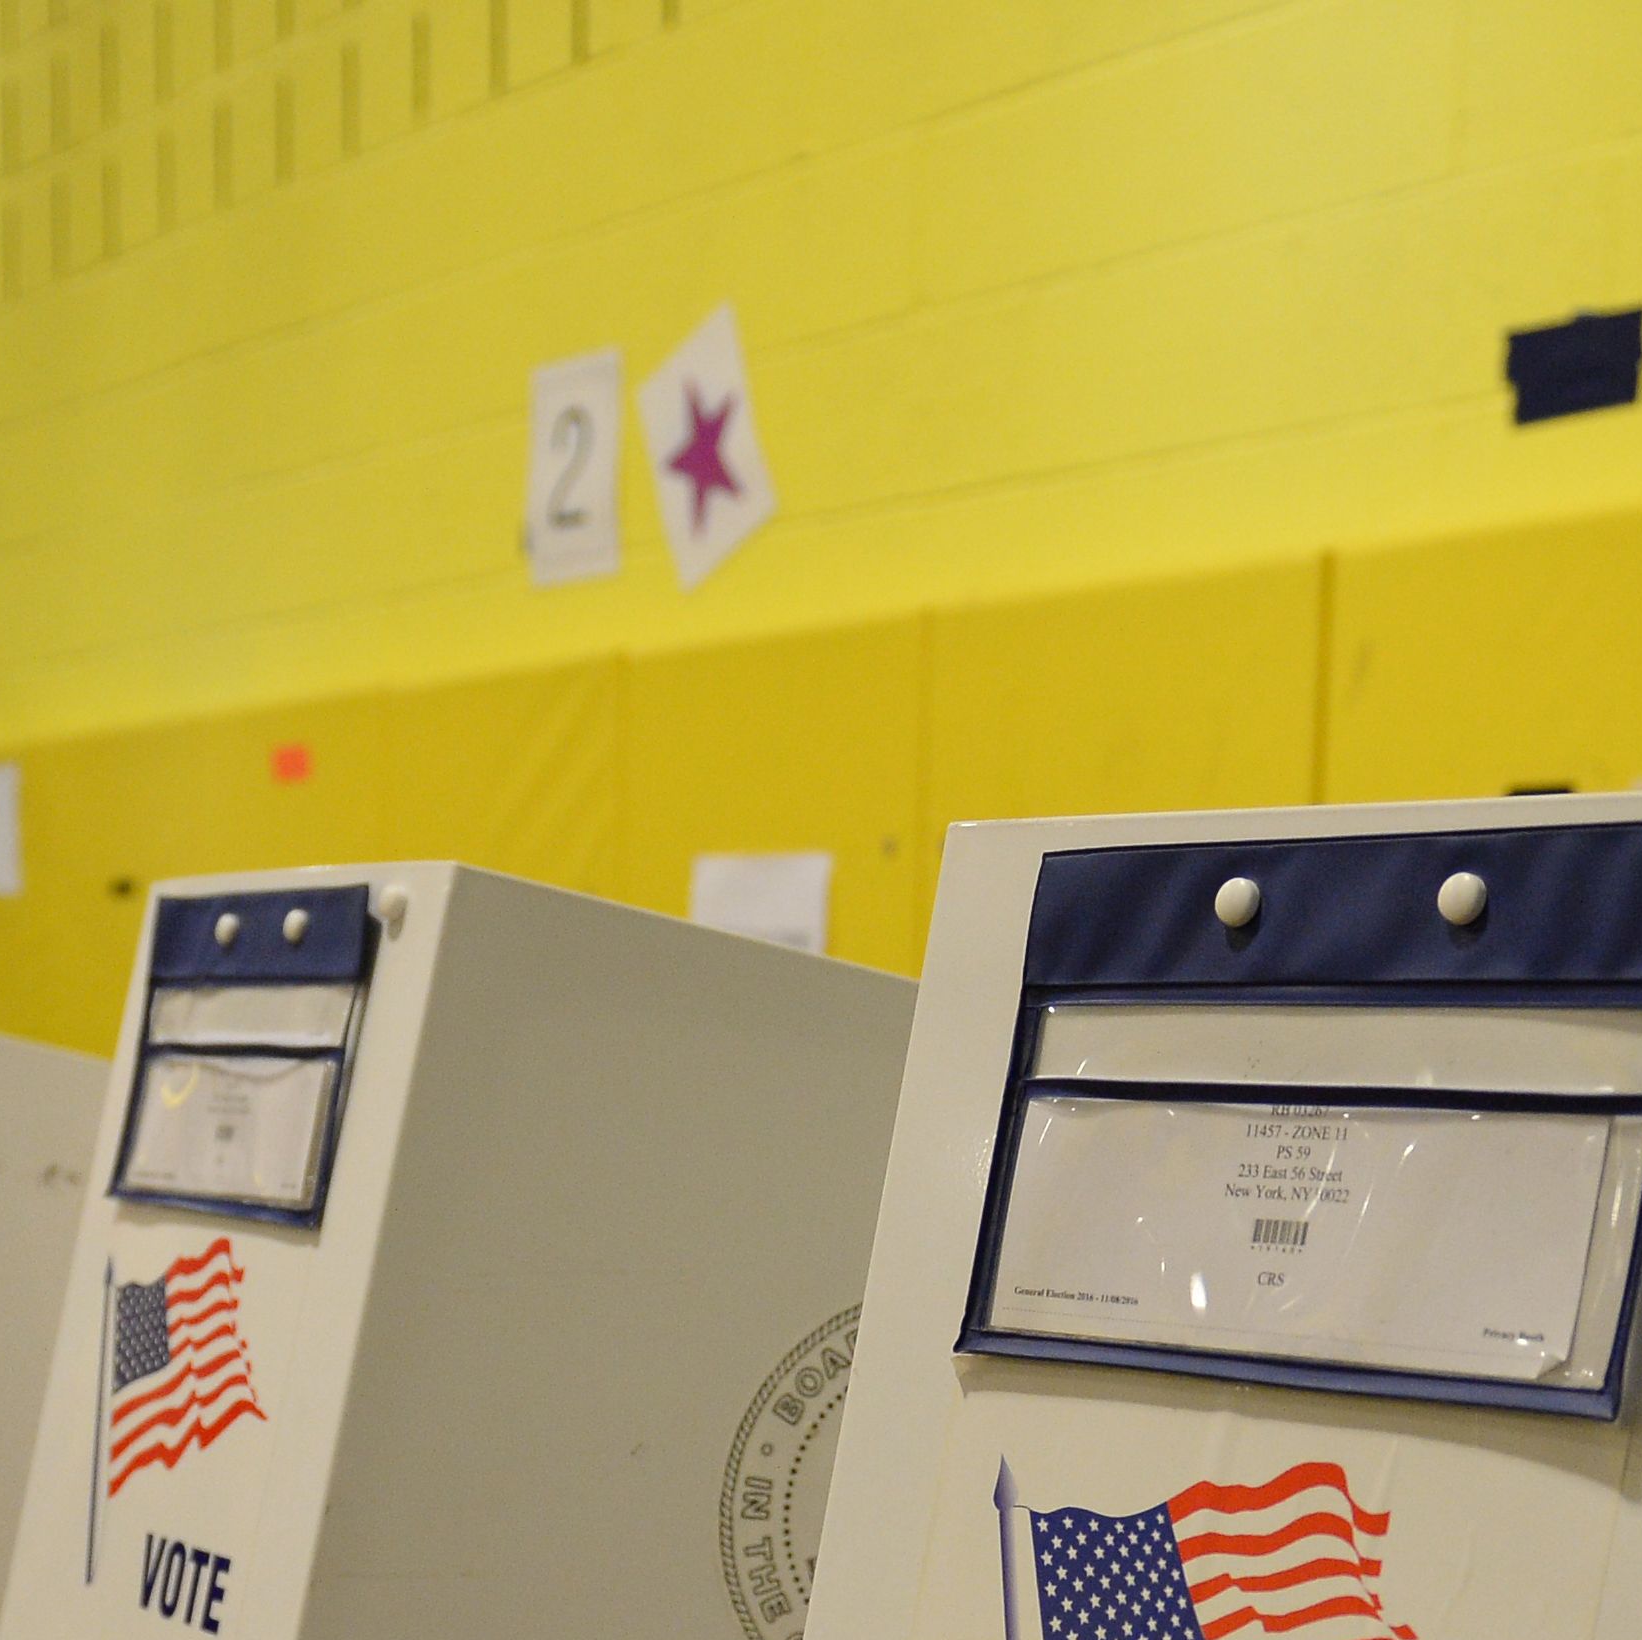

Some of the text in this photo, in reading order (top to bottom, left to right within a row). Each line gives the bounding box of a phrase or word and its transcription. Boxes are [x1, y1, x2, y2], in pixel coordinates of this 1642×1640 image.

[547, 404, 595, 530] 2
[1246, 1122, 1282, 1138] 11457
[1292, 1124, 1331, 1140] ZONE
[1335, 1126, 1348, 1140] 11
[1277, 1145, 1311, 1160] PS 59
[1238, 1163, 1342, 1182] 233 East 56 Street
[1225, 1183, 1250, 1197] New
[1256, 1184, 1287, 1200] York,
[1292, 1187, 1311, 1201] NY
[1257, 1271, 1285, 1286] CRS
[1014, 1286, 1044, 1296] General
[1046, 1289, 1075, 1300] Election
[741, 1475, 792, 1624] IN THE
[138, 1533, 231, 1635] VOTE
